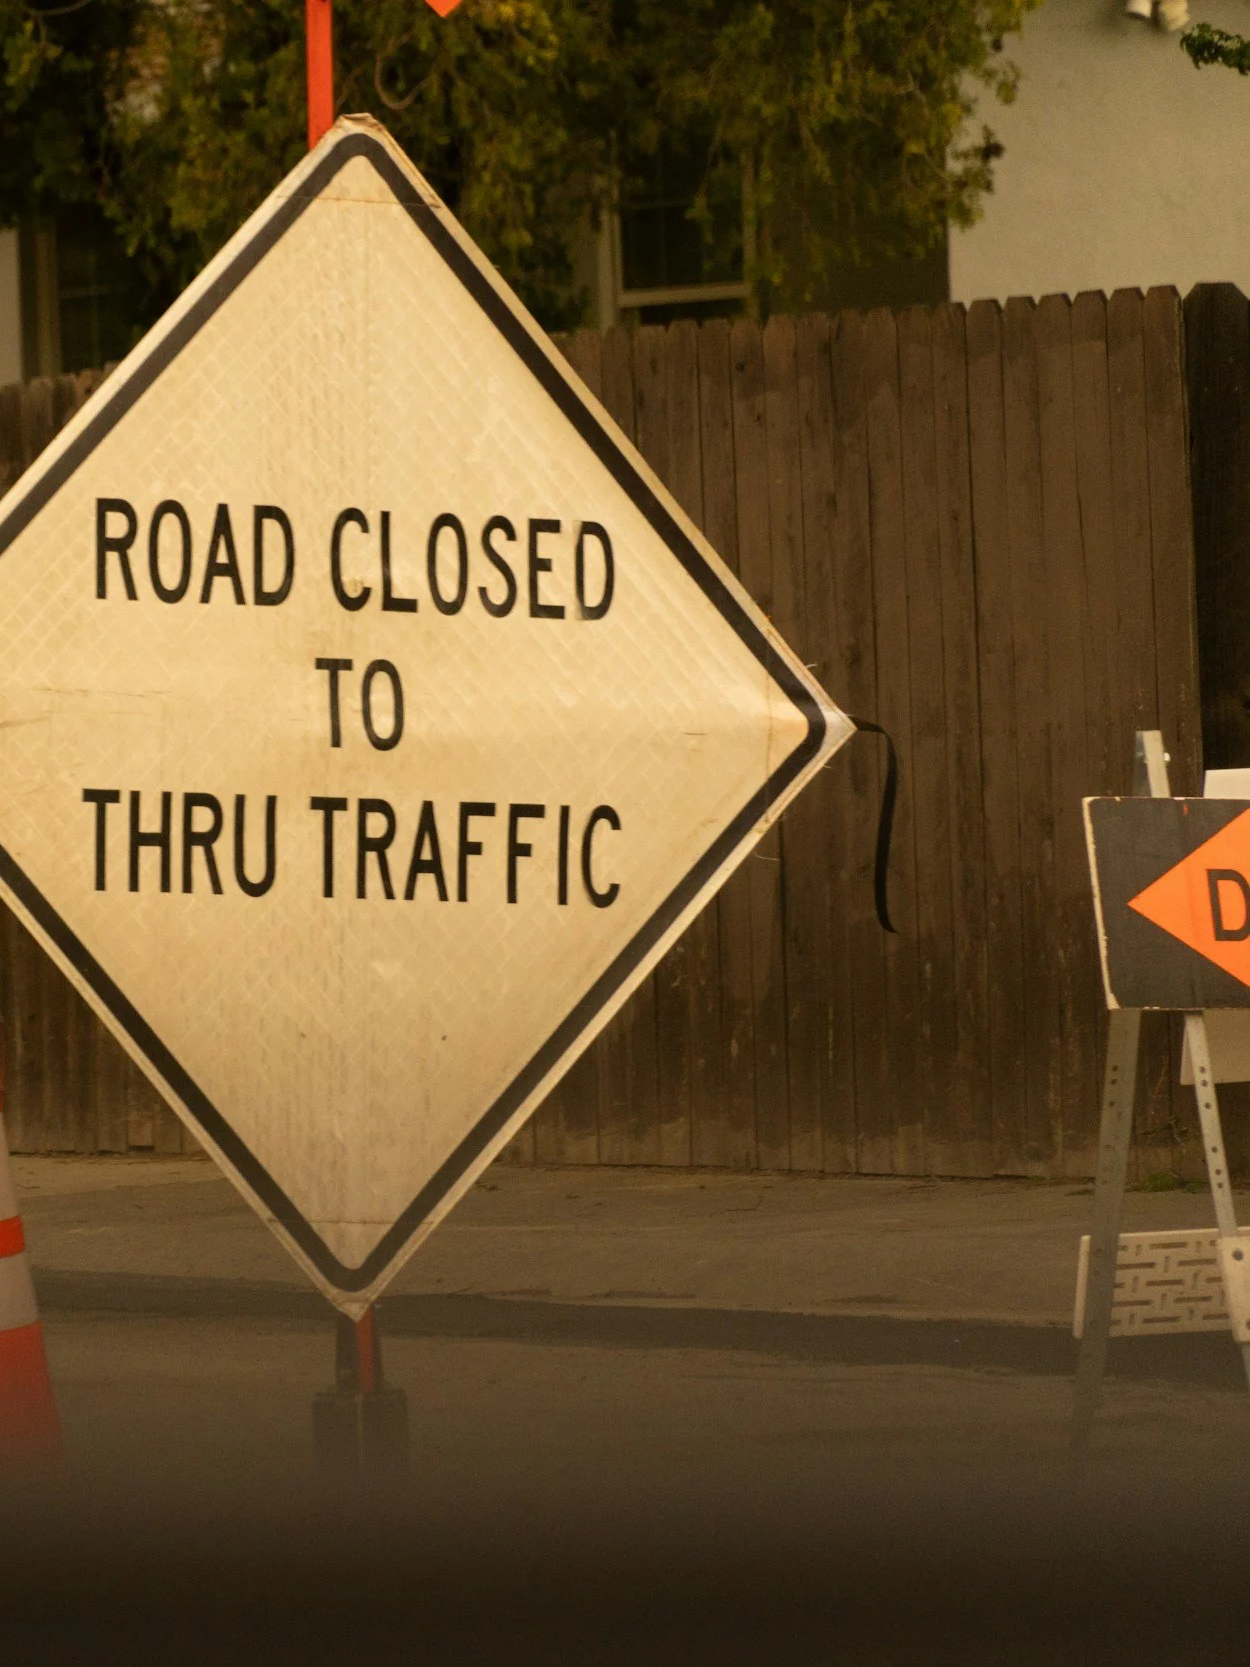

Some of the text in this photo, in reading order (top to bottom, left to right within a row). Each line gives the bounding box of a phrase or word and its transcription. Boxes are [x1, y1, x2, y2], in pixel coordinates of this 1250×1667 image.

[95, 497, 615, 621] ROAD CLOSED
[315, 657, 404, 751] TO
[82, 788, 621, 908] THRU TRAFFIC
